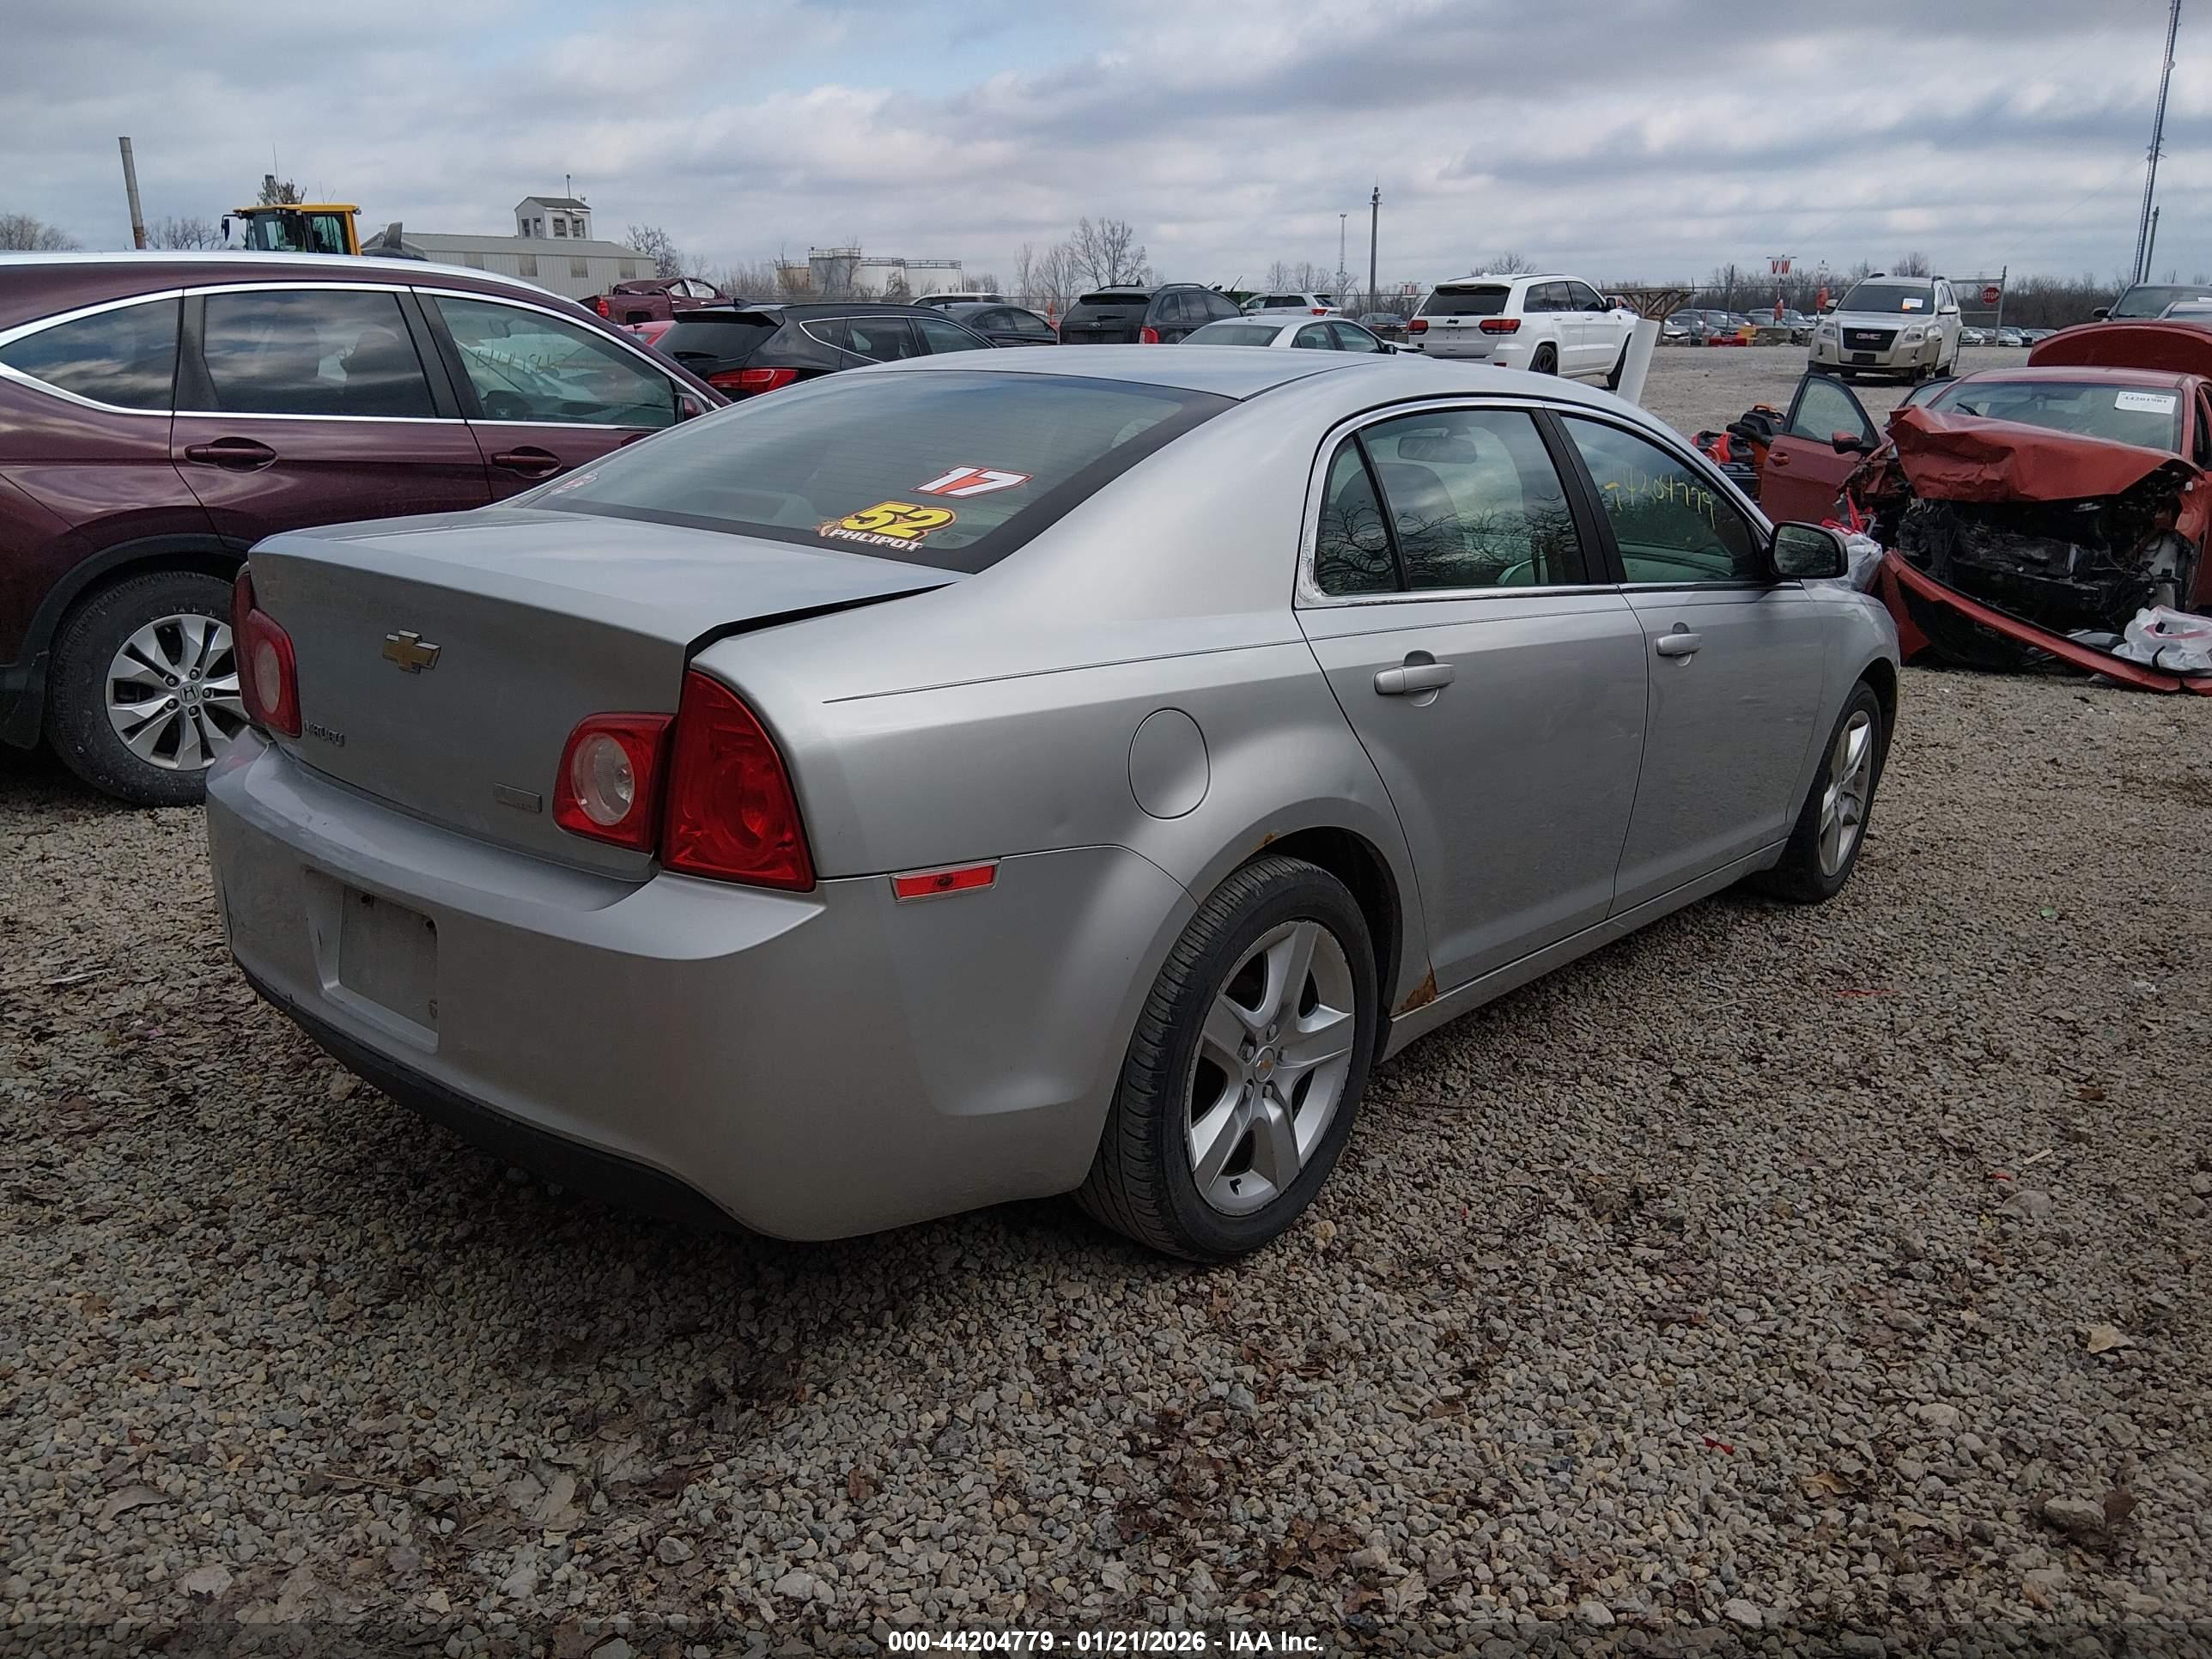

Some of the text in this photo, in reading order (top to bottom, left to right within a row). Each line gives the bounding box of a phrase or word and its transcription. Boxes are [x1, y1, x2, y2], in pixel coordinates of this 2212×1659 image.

[911, 465, 1033, 499] 17
[841, 501, 956, 540] 52
[829, 529, 923, 552] PHLIPOT
